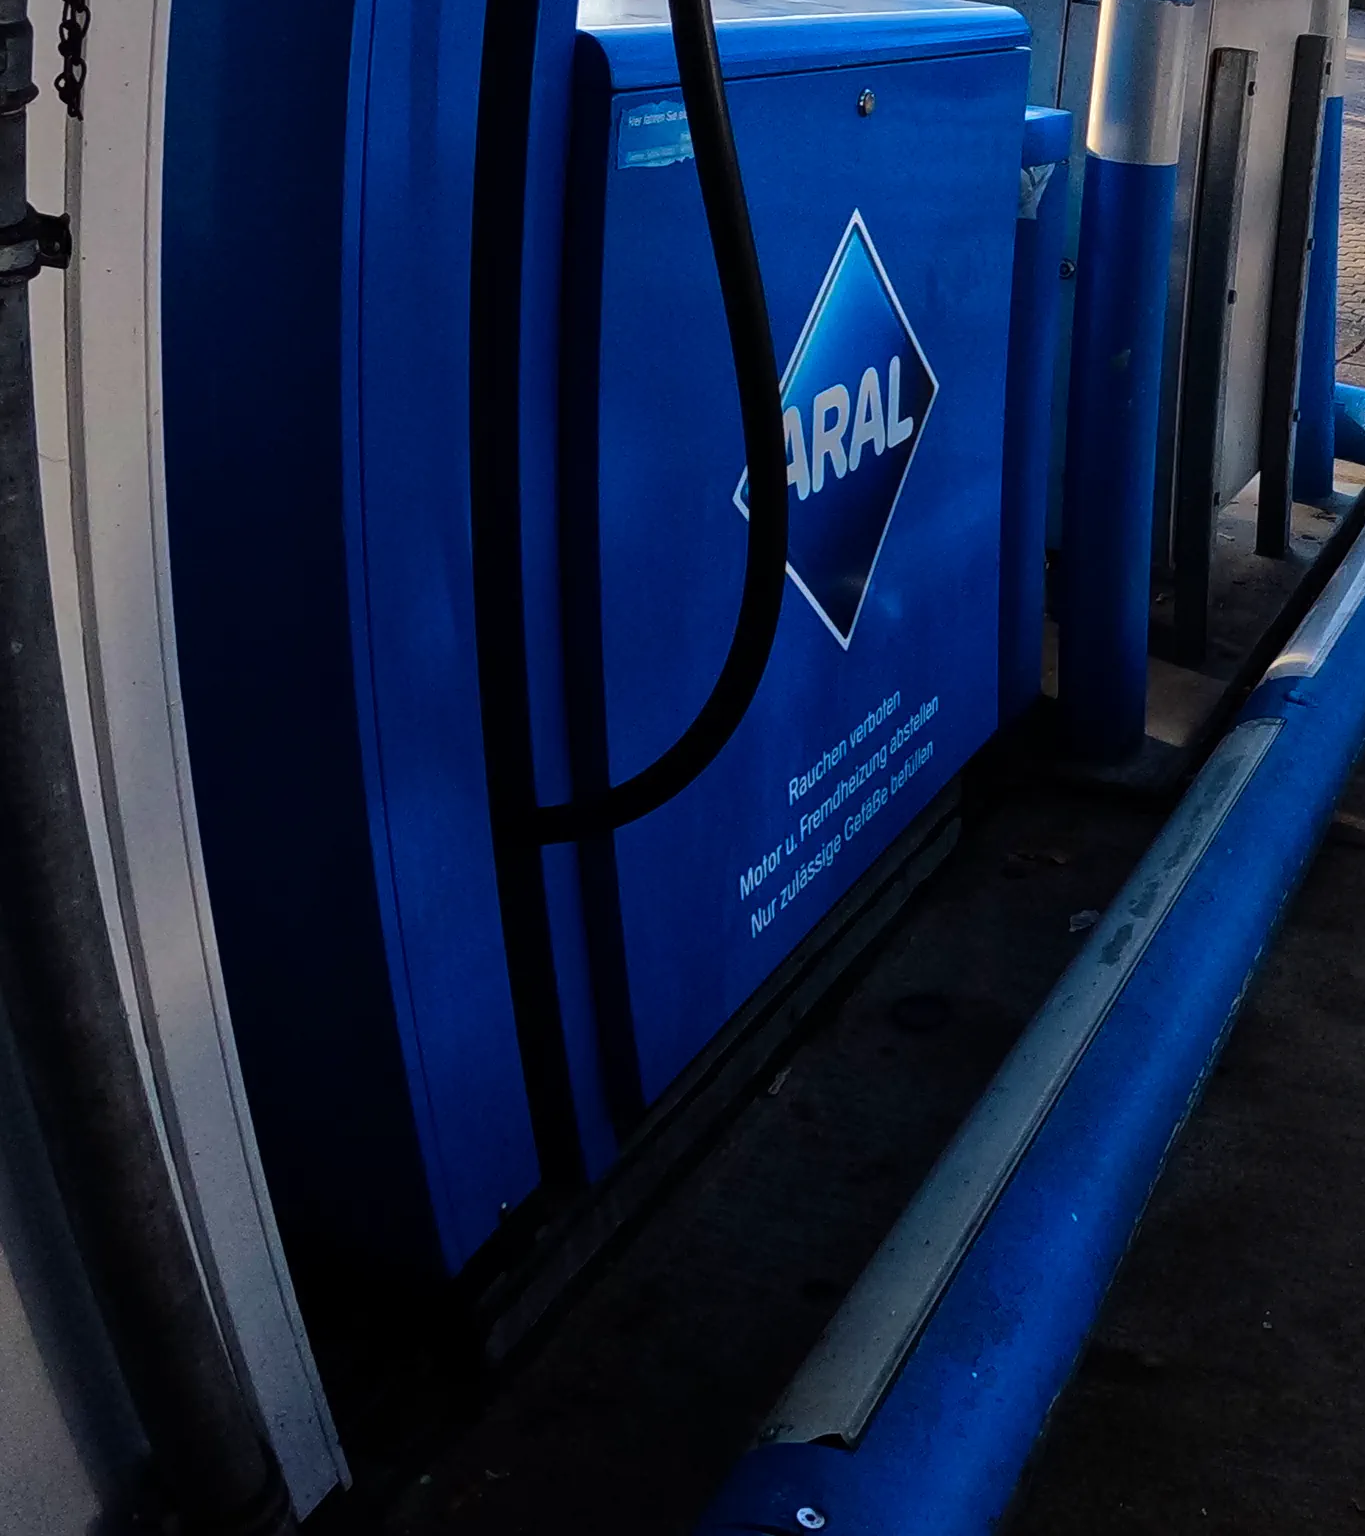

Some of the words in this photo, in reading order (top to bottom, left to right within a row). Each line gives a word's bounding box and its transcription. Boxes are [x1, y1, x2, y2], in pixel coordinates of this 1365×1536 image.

[781, 356, 914, 501] ARAL
[740, 843, 782, 901] Motor
[786, 834, 798, 855] u.
[800, 743, 888, 842] Fremdheizung
[890, 695, 939, 754] abstellen
[789, 738, 846, 805] Rauchen
[850, 690, 901, 748] verboten
[750, 901, 776, 938] Nur
[780, 837, 841, 912] zulässige
[844, 787, 888, 842] Gefäße
[890, 740, 934, 795] befüllen
